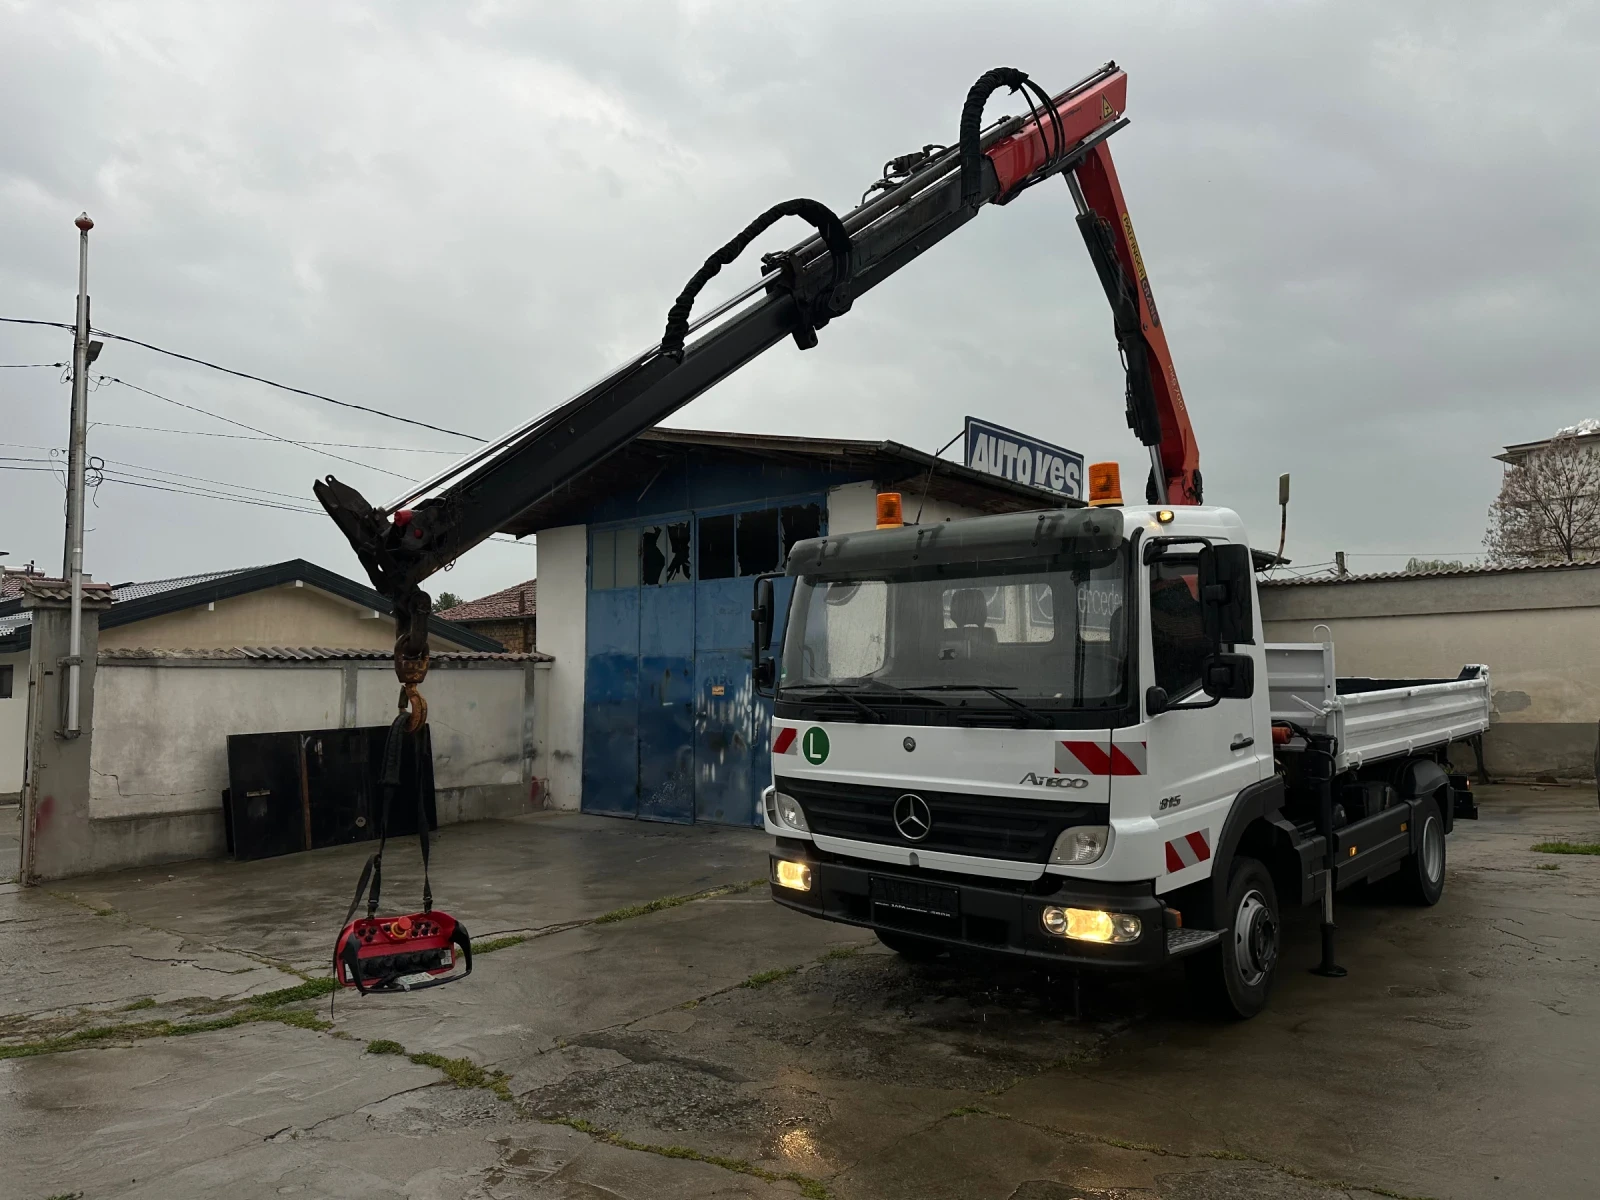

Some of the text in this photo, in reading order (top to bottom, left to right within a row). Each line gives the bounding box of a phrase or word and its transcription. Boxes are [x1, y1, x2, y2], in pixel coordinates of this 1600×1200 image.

[1123, 216, 1158, 325] PALFINGER CRANE
[970, 432, 1033, 486] AUTO
[809, 732, 822, 759] L
[1159, 795, 1182, 810] 815
